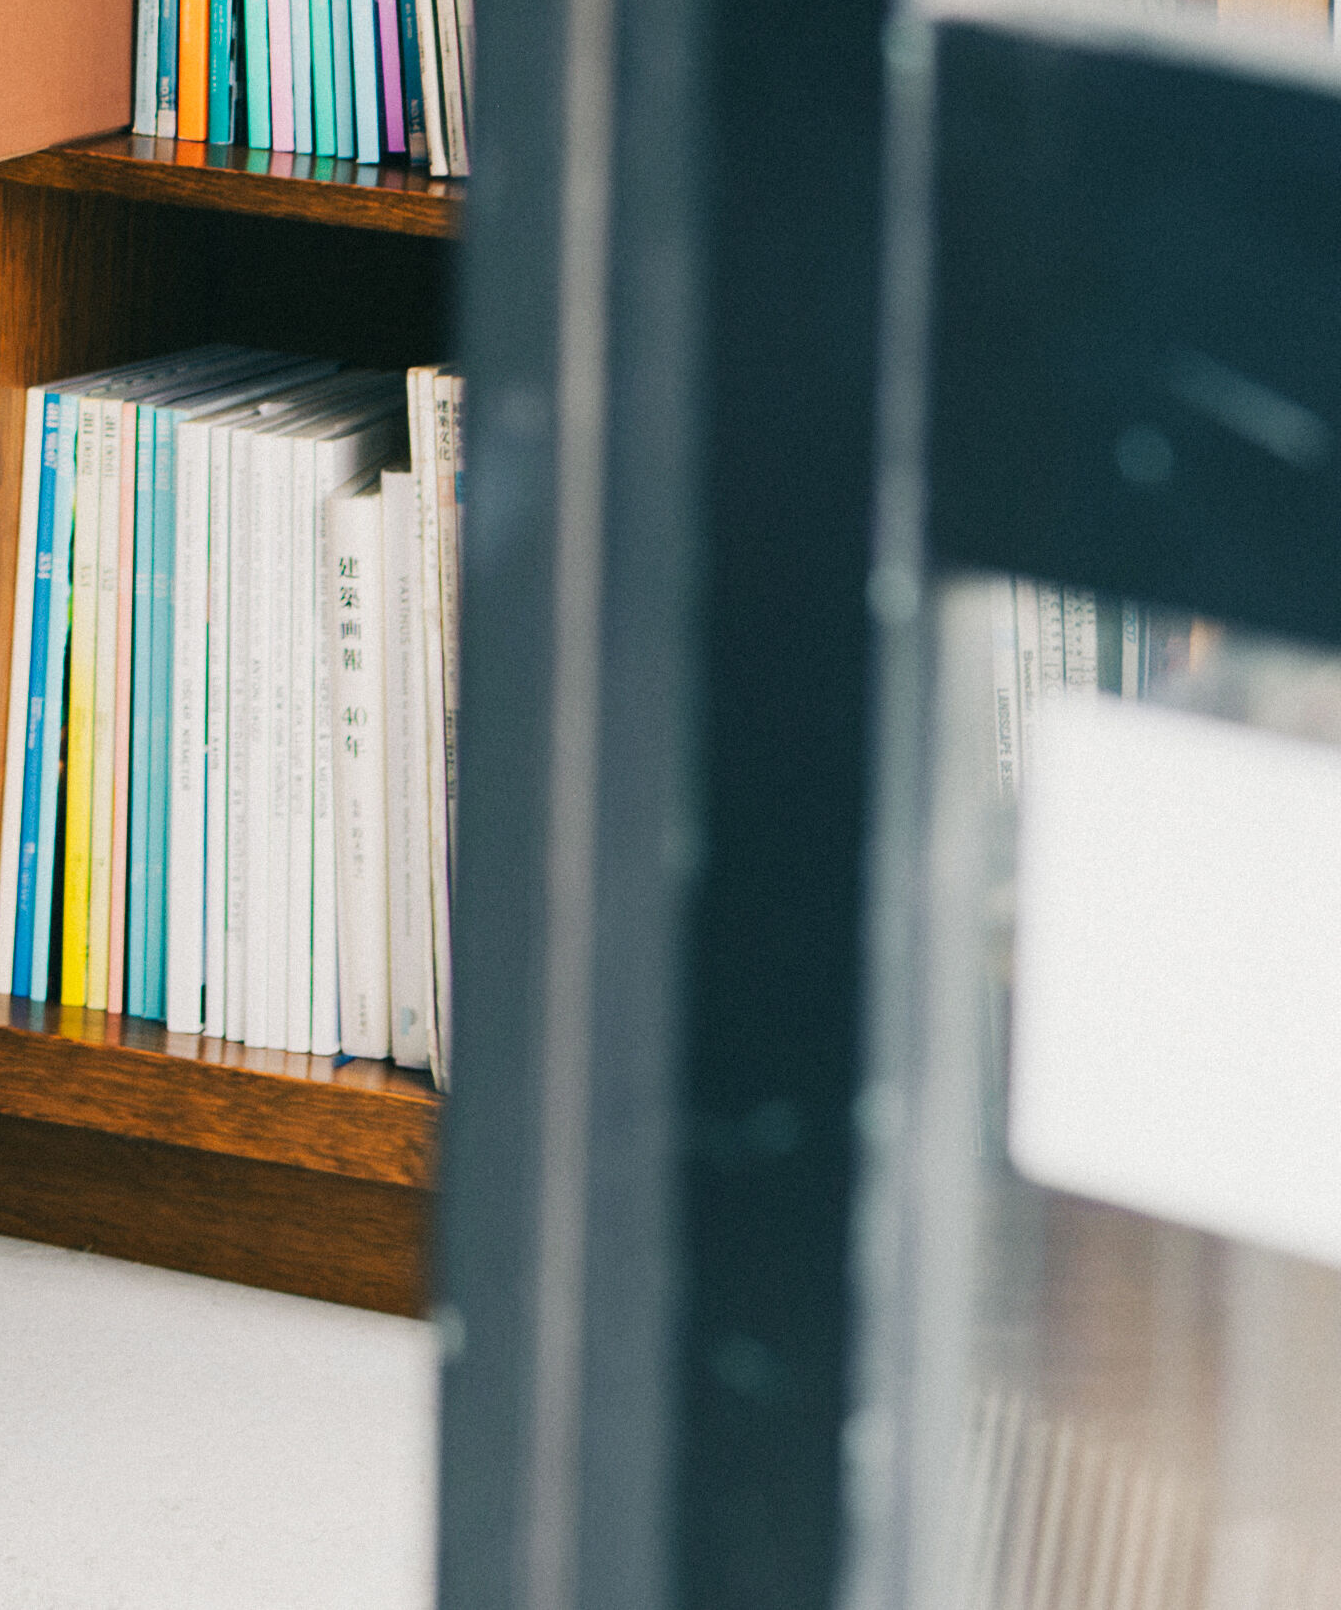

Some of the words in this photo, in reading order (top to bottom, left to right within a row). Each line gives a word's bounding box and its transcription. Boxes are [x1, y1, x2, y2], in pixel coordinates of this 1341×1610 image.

[337, 555, 364, 671] 建築画報
[341, 706, 368, 730] 40
[994, 687, 1013, 755] LANDSCAPE
[344, 735, 366, 759] 年
